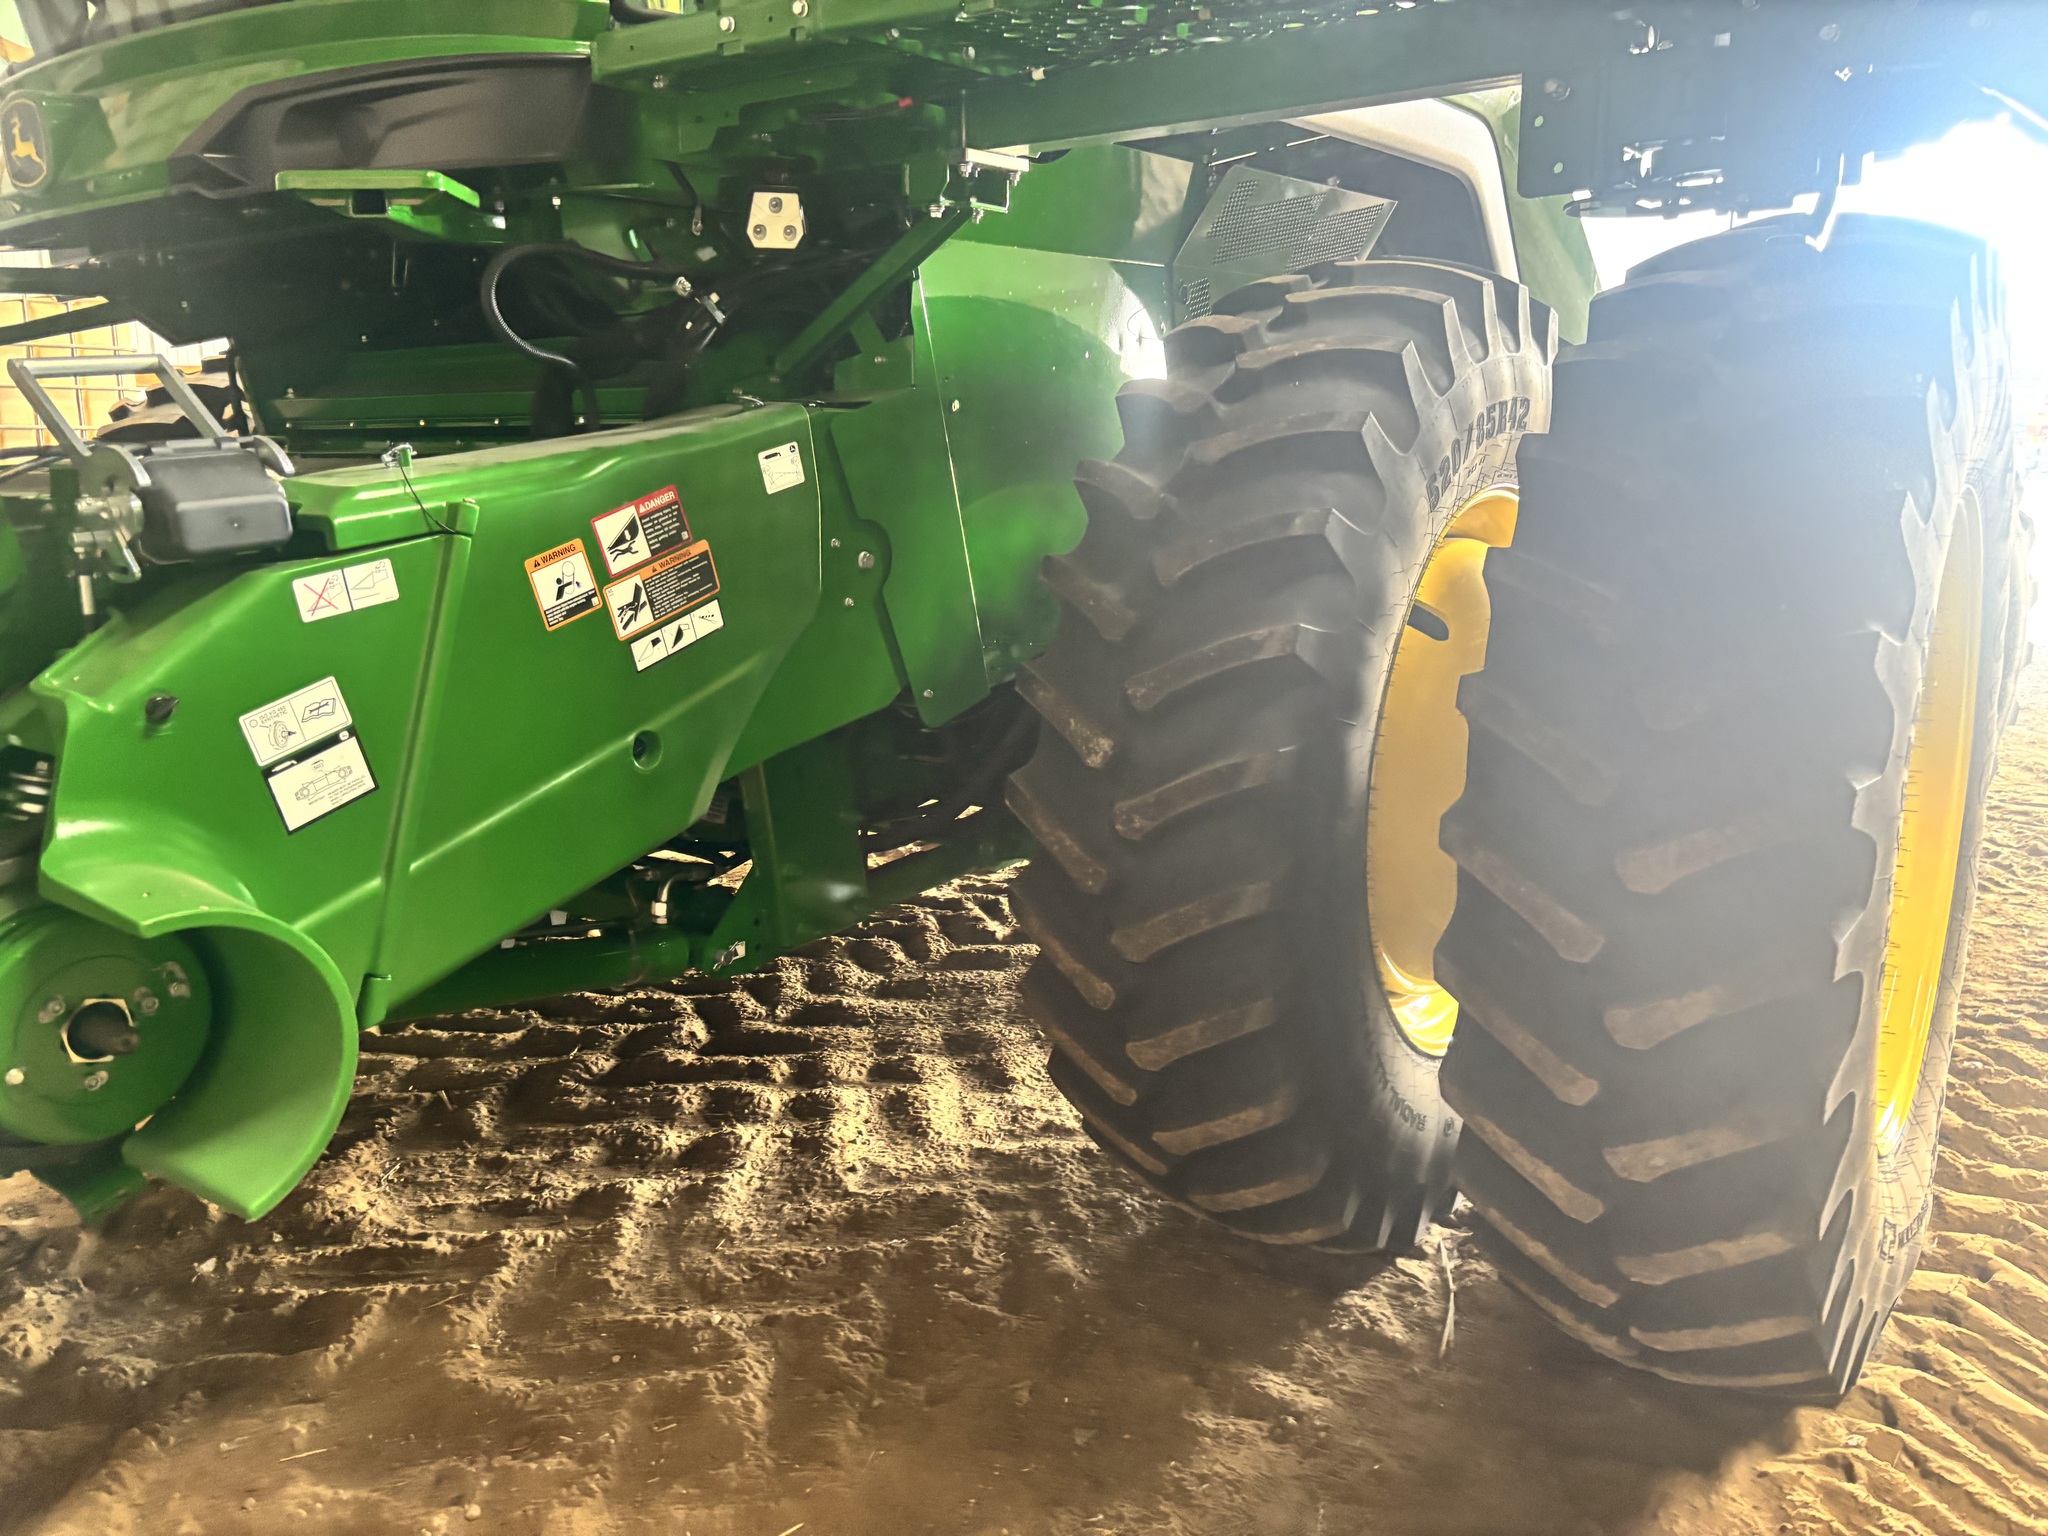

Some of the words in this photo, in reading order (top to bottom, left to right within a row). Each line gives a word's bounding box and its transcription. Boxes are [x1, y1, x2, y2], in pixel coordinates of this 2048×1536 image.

[1426, 396, 1530, 513] 520/85R42
[644, 491, 676, 511] DANGER
[540, 543, 576, 564] WARNING
[658, 549, 692, 569] WARNING
